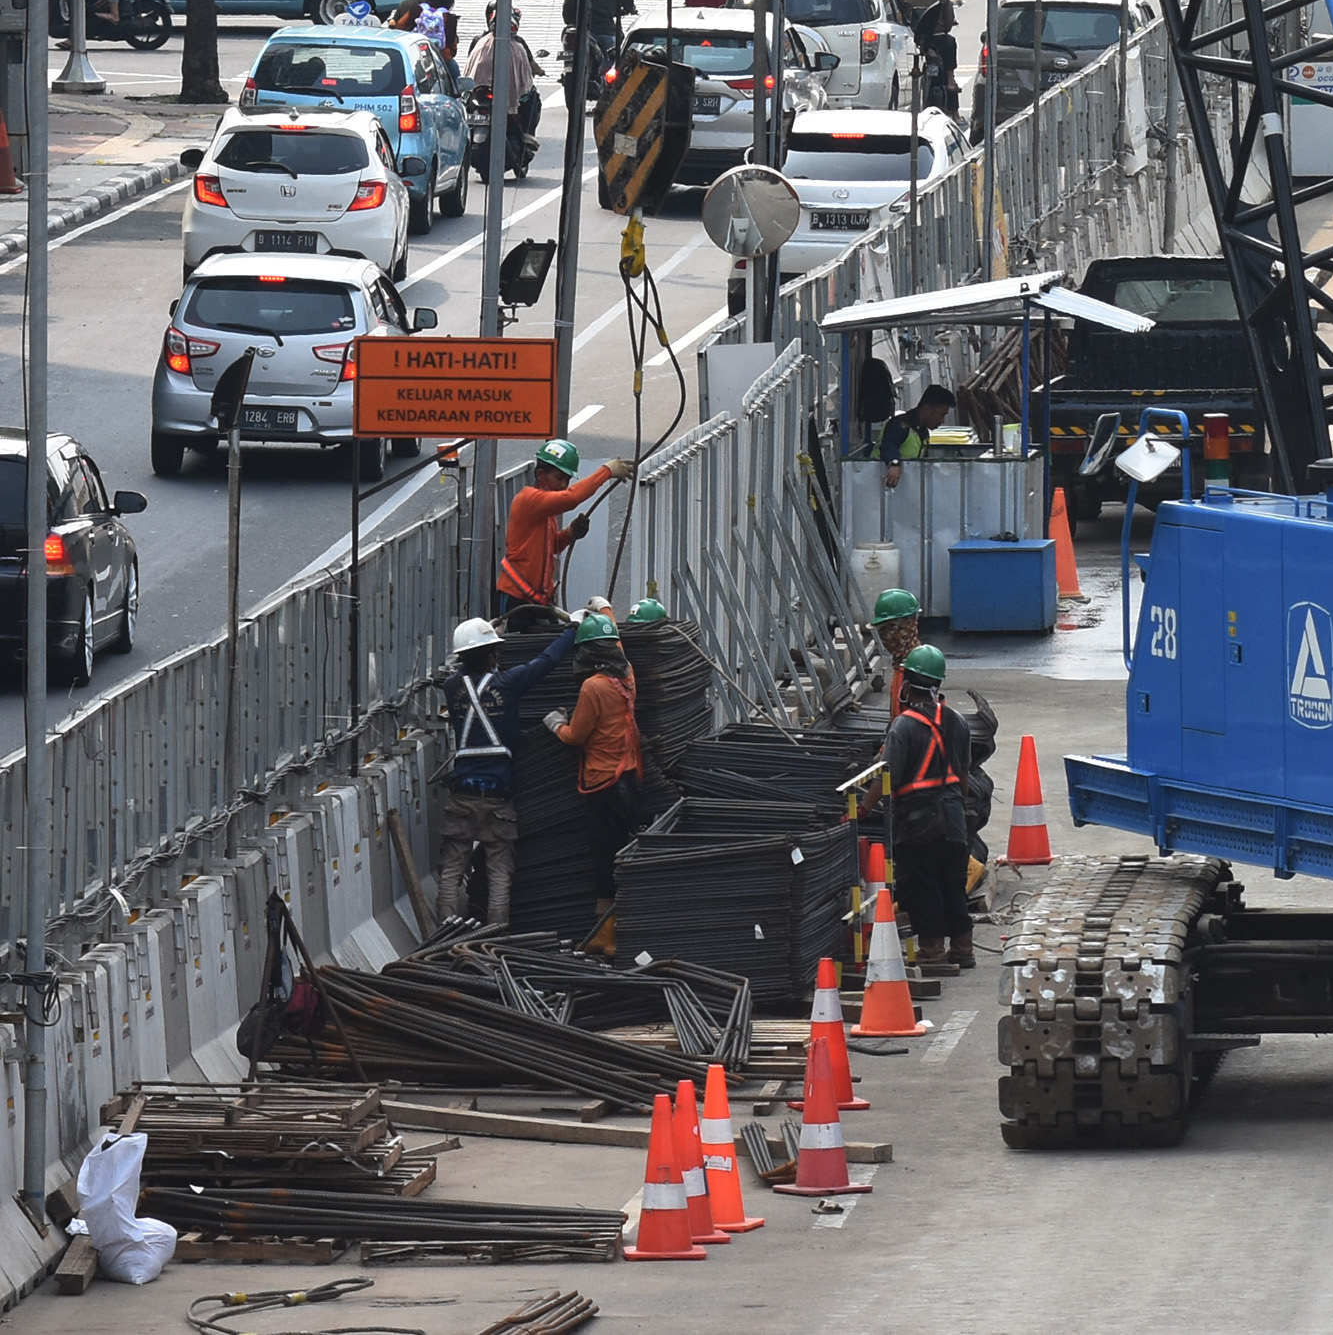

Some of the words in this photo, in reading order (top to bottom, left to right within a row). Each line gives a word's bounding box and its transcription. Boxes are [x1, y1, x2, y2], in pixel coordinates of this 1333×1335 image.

[354, 103, 375, 112] PHM
[376, 104, 393, 112] 502
[813, 213, 819, 224] B
[826, 213, 847, 225] 1313
[258, 235, 265, 244] B
[271, 235, 292, 245] 1114
[397, 388, 453, 401] KELUAR
[457, 389, 512, 402] MASUK
[245, 411, 268, 423] 1284
[277, 412, 295, 423] ERB
[377, 409, 470, 422] KENDARAAN
[474, 410, 532, 423] PROYEK
[1150, 605, 1177, 660] 28
